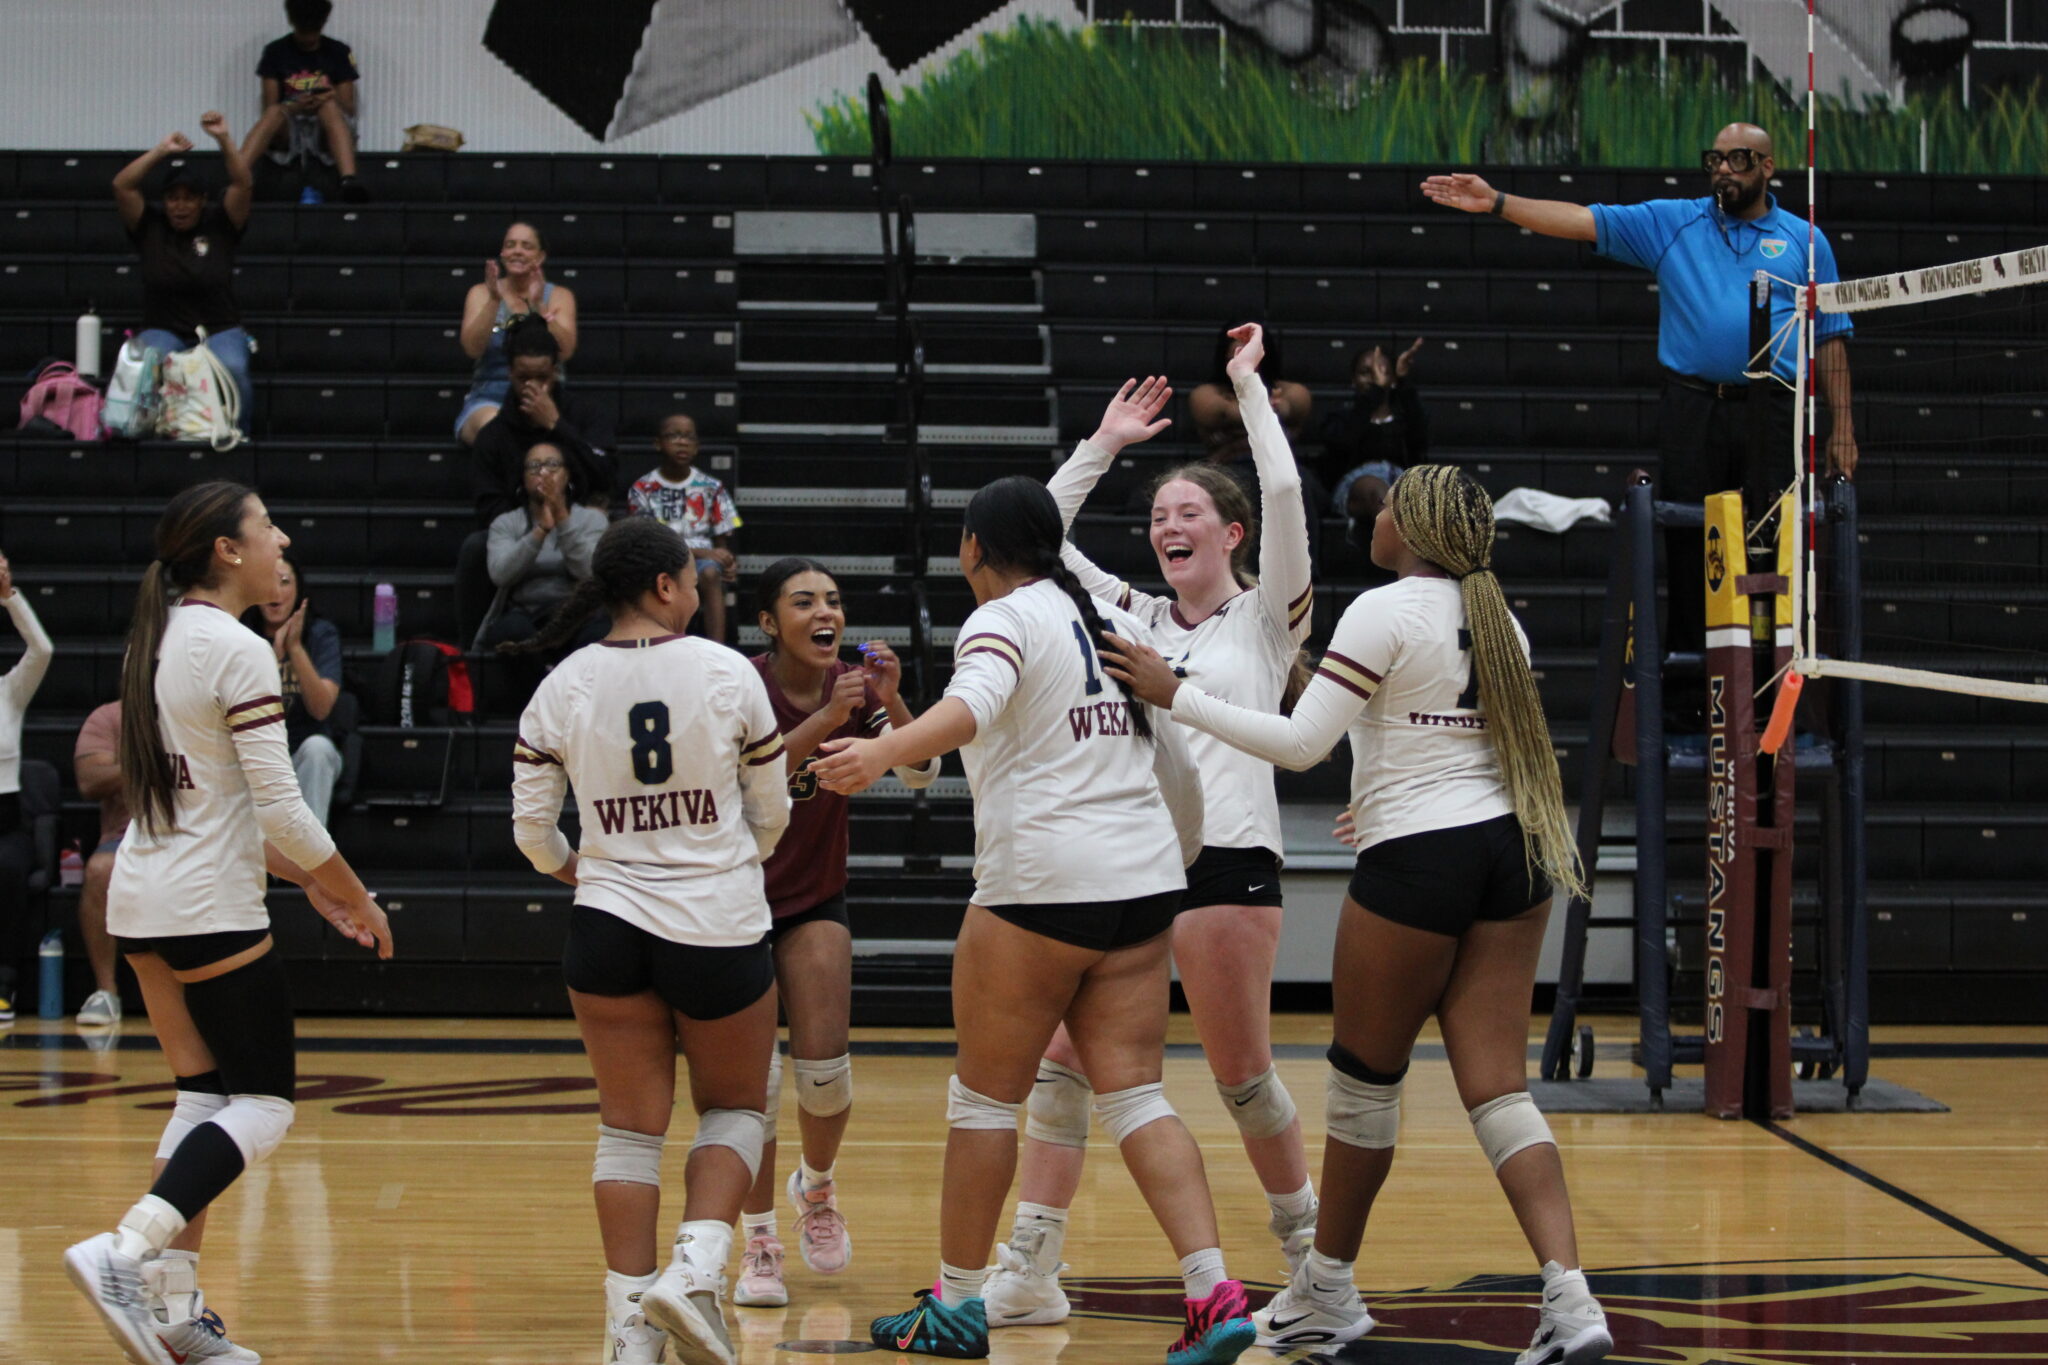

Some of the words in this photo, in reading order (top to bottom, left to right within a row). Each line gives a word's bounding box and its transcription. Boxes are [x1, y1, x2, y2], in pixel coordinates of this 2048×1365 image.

[628, 700, 673, 785] 8
[1068, 701, 1150, 742] WEKI
[593, 789, 719, 835] WEKIVA
[1726, 760, 1735, 863] WEKIVA
[1707, 675, 1726, 1044] MUSTANGS
